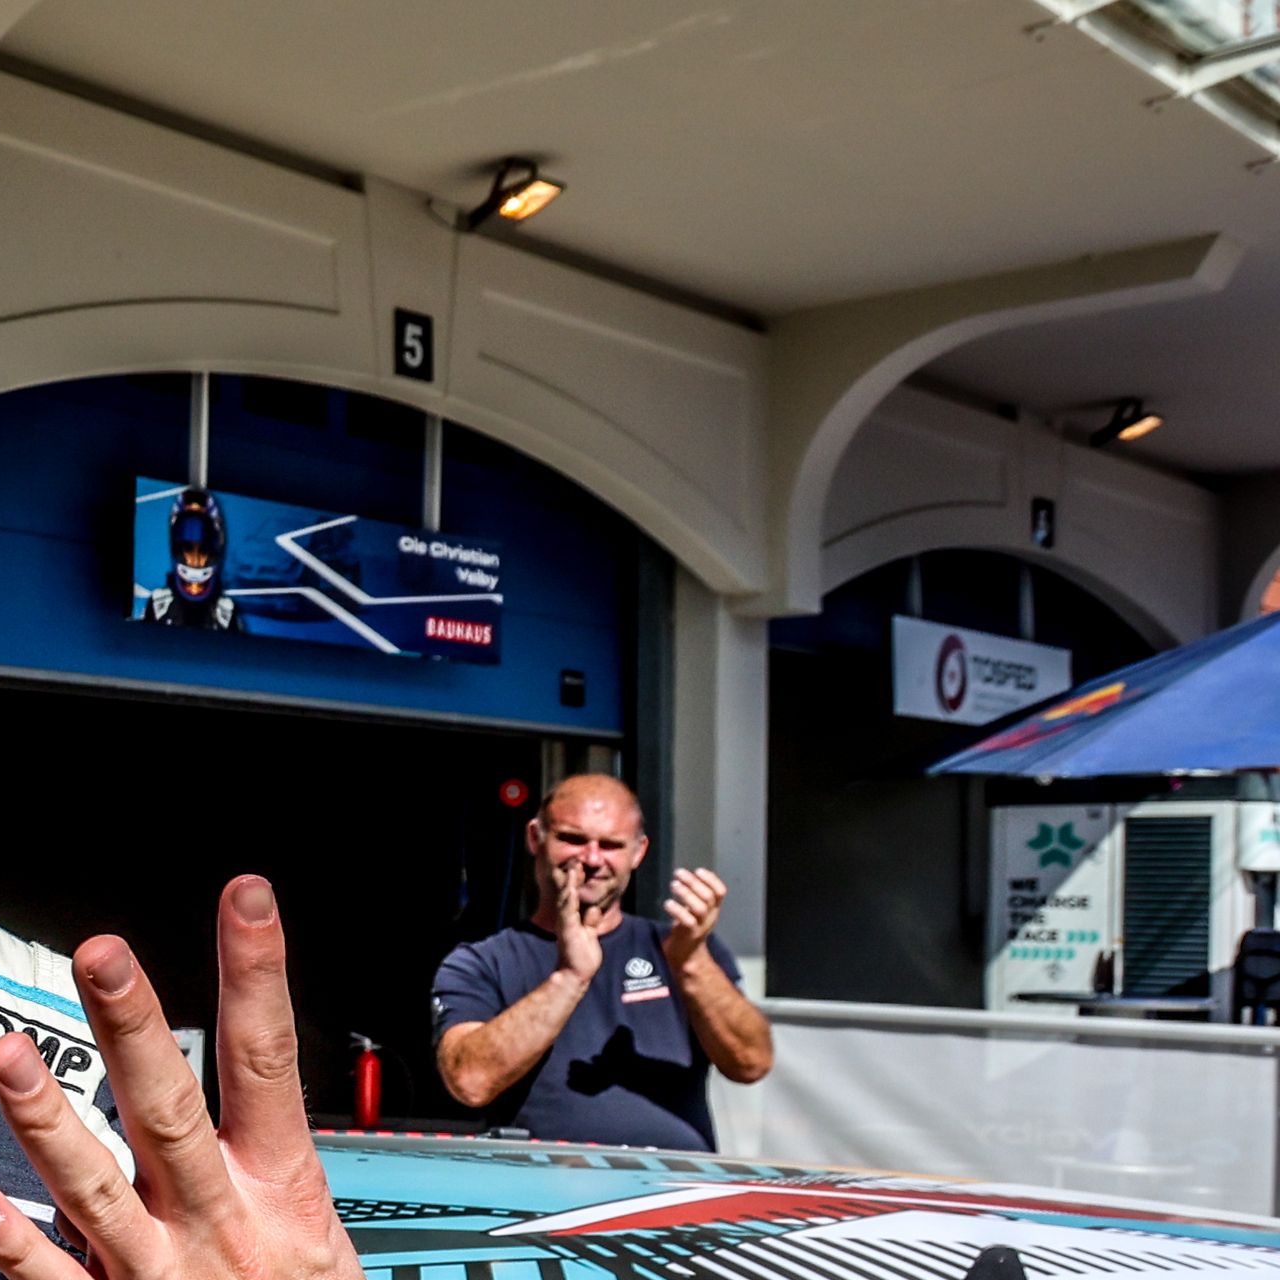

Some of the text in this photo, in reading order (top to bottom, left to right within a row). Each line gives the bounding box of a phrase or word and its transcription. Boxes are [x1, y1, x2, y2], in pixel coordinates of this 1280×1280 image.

[402, 322, 424, 369] 5
[429, 540, 500, 567] Christian
[426, 617, 492, 644] BAUHAUS
[1008, 877, 1039, 891] WE
